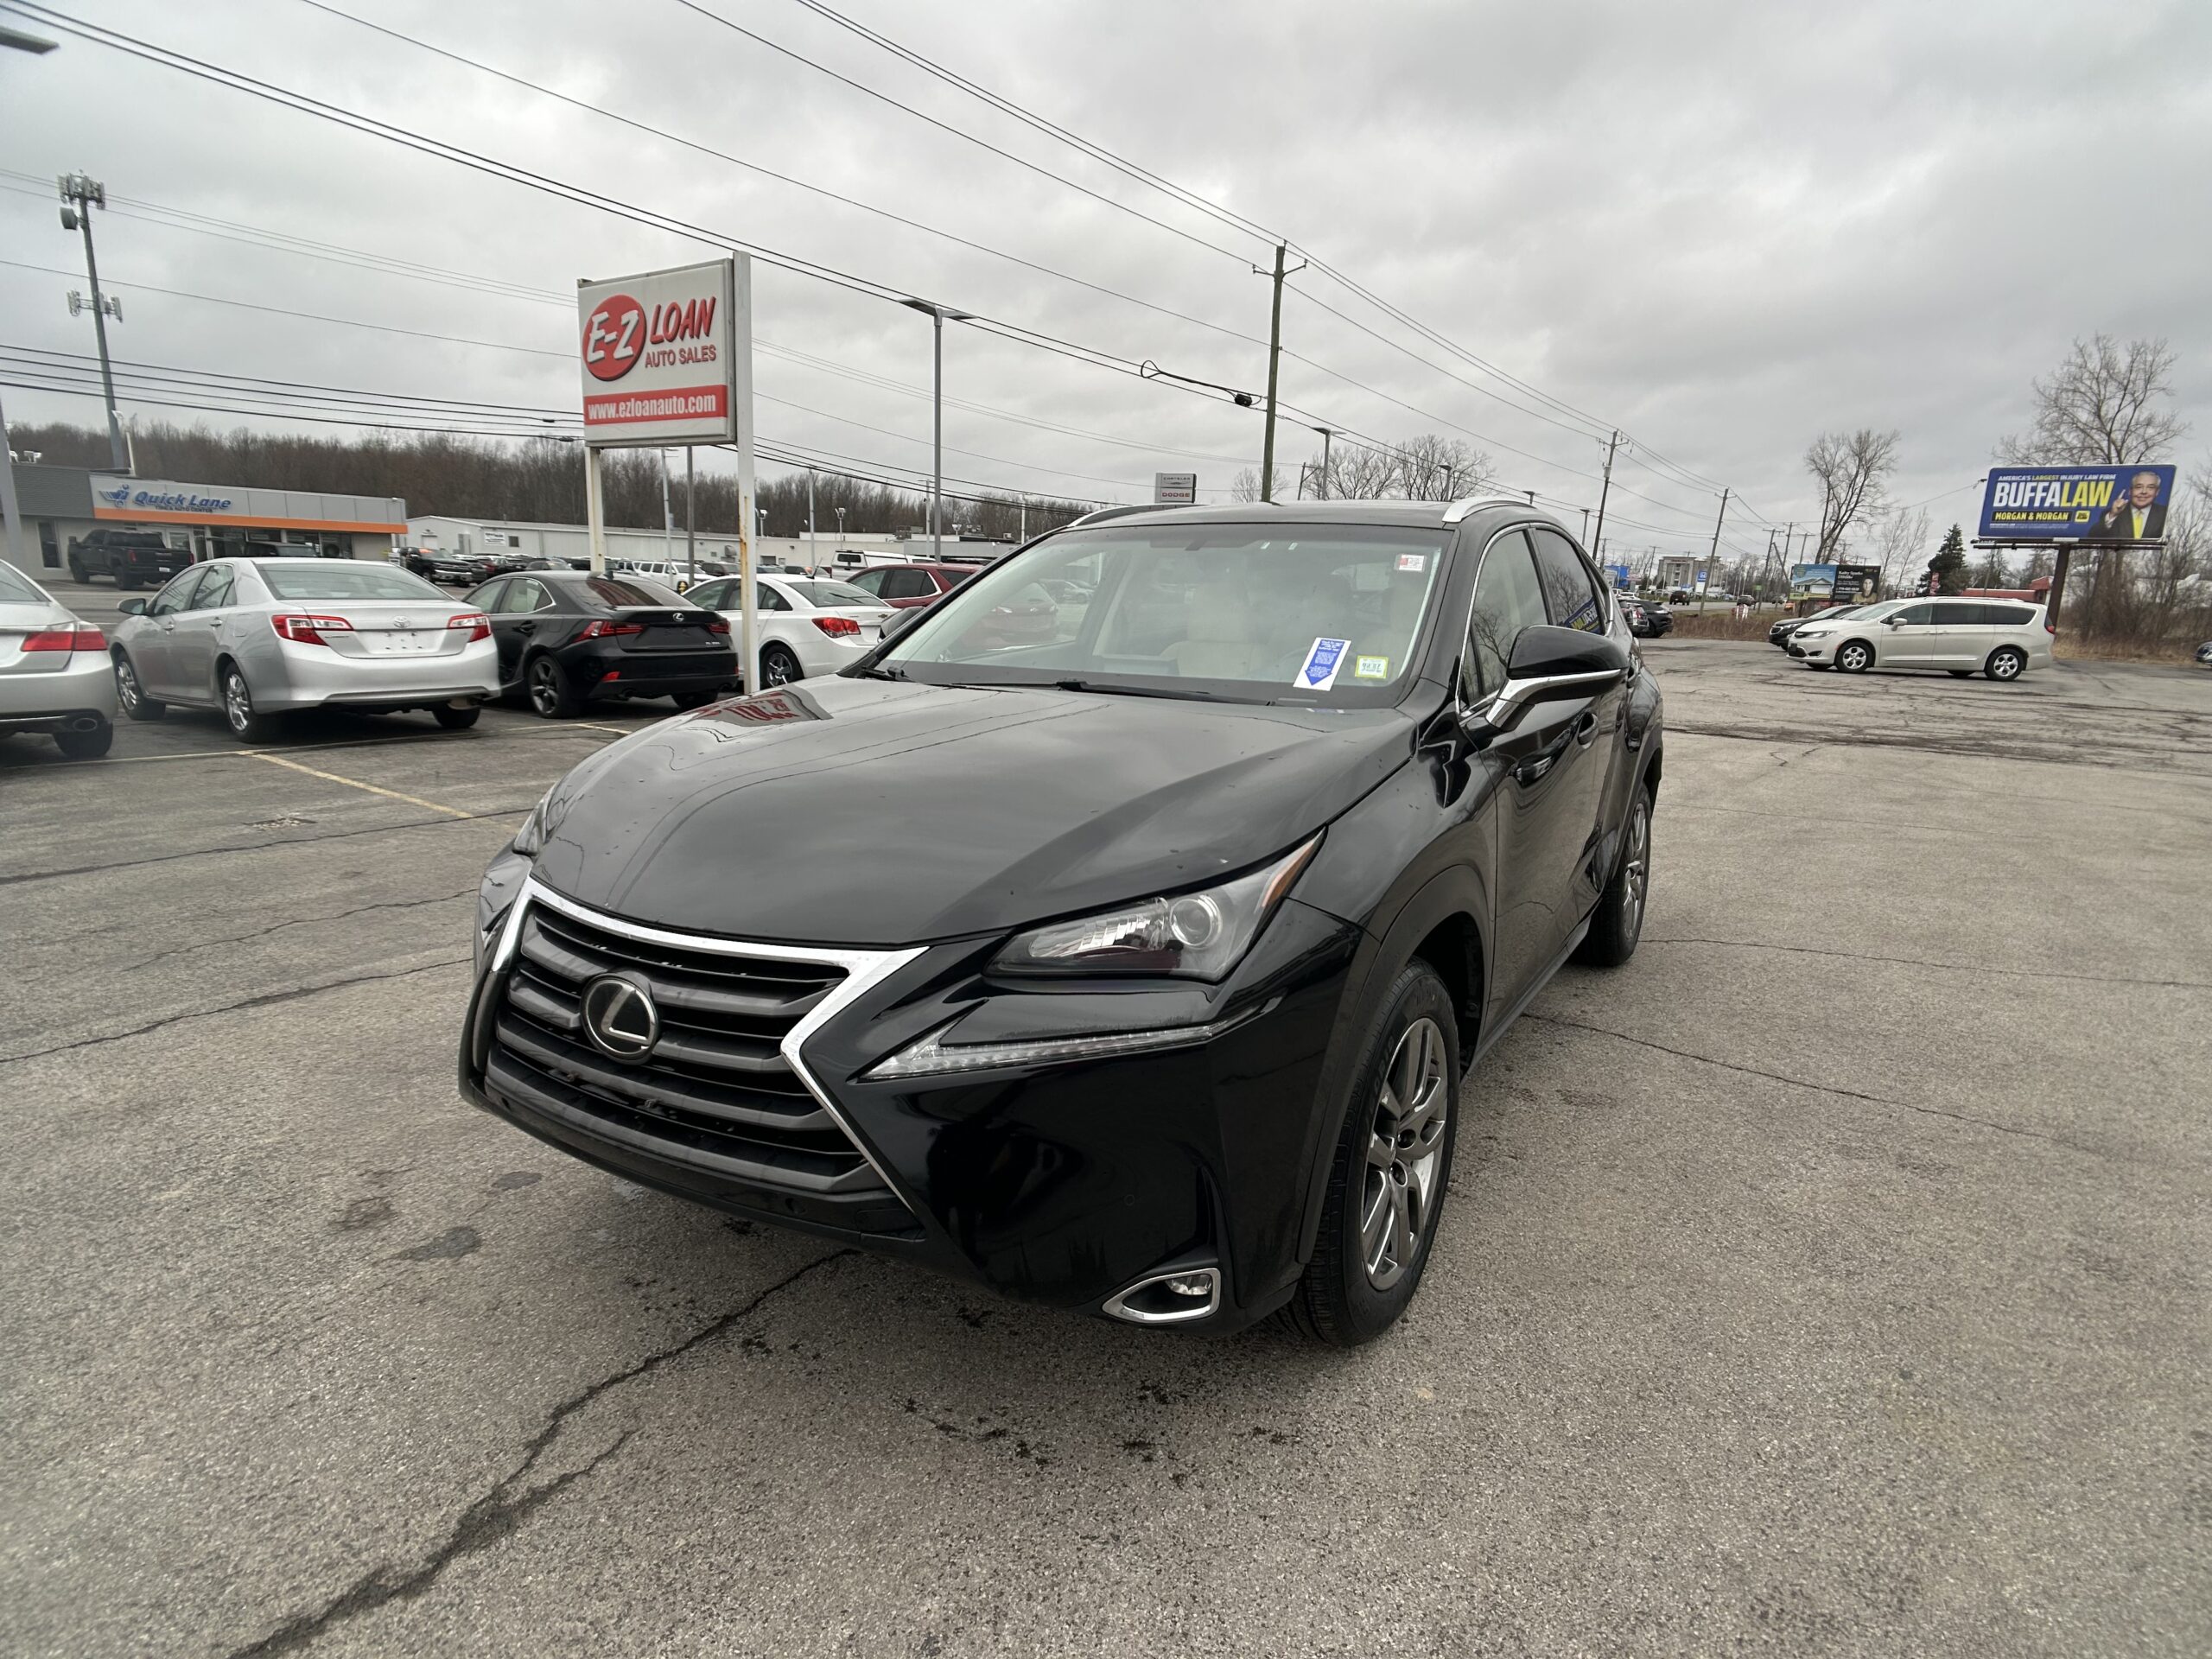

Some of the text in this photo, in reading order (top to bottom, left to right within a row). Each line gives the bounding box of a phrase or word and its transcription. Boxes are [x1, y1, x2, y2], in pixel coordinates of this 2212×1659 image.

[587, 296, 716, 364] E-Z LOAN
[645, 345, 716, 368] AUTO SALES
[588, 394, 716, 420] www.ezloanauto.com
[133, 491, 232, 510] Quick Lane
[1993, 481, 2115, 507] BUFFALAW
[1994, 512, 2026, 520] MORGAN
[2028, 512, 2034, 520] &
[2035, 512, 2069, 520] MORGAN
